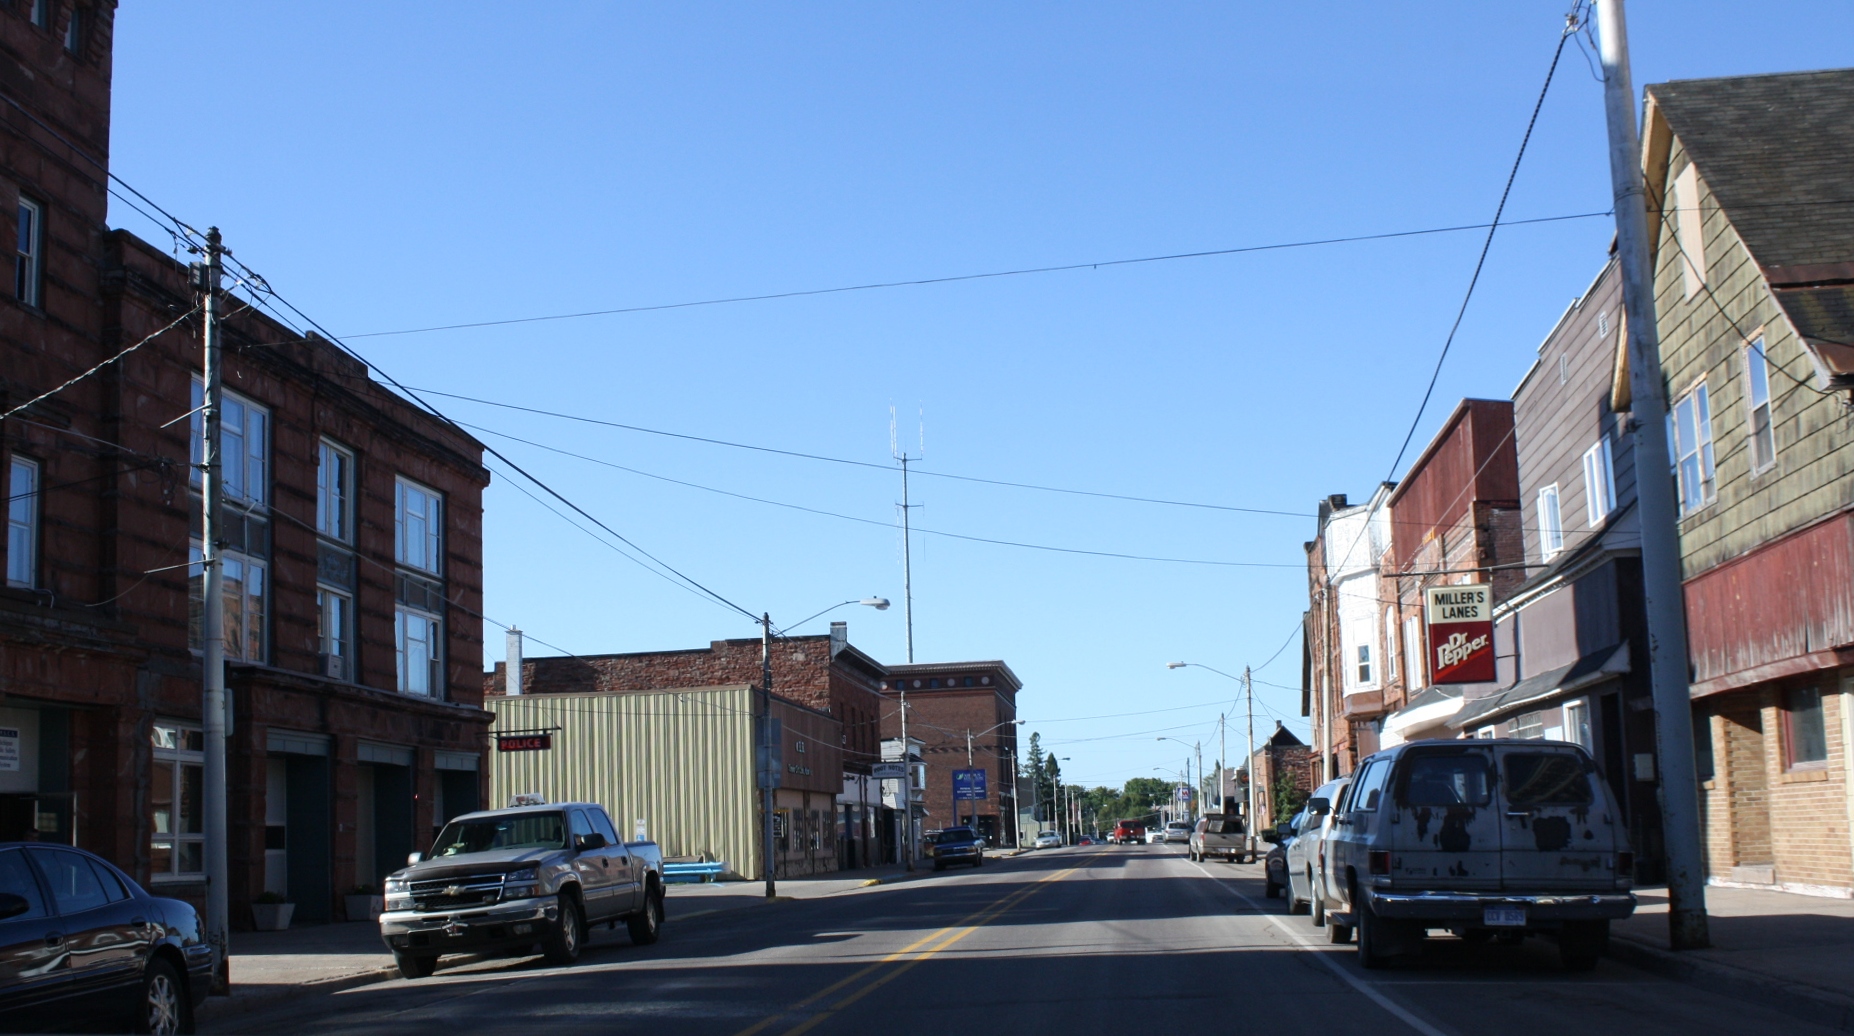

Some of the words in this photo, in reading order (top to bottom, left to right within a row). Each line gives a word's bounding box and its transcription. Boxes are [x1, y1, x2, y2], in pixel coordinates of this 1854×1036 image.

[1435, 592, 1485, 606] MILLER'S
[1442, 606, 1478, 619] LANES
[1448, 632, 1468, 647] Dr
[1437, 634, 1489, 670] Pepper
[500, 738, 542, 750] POLICE
